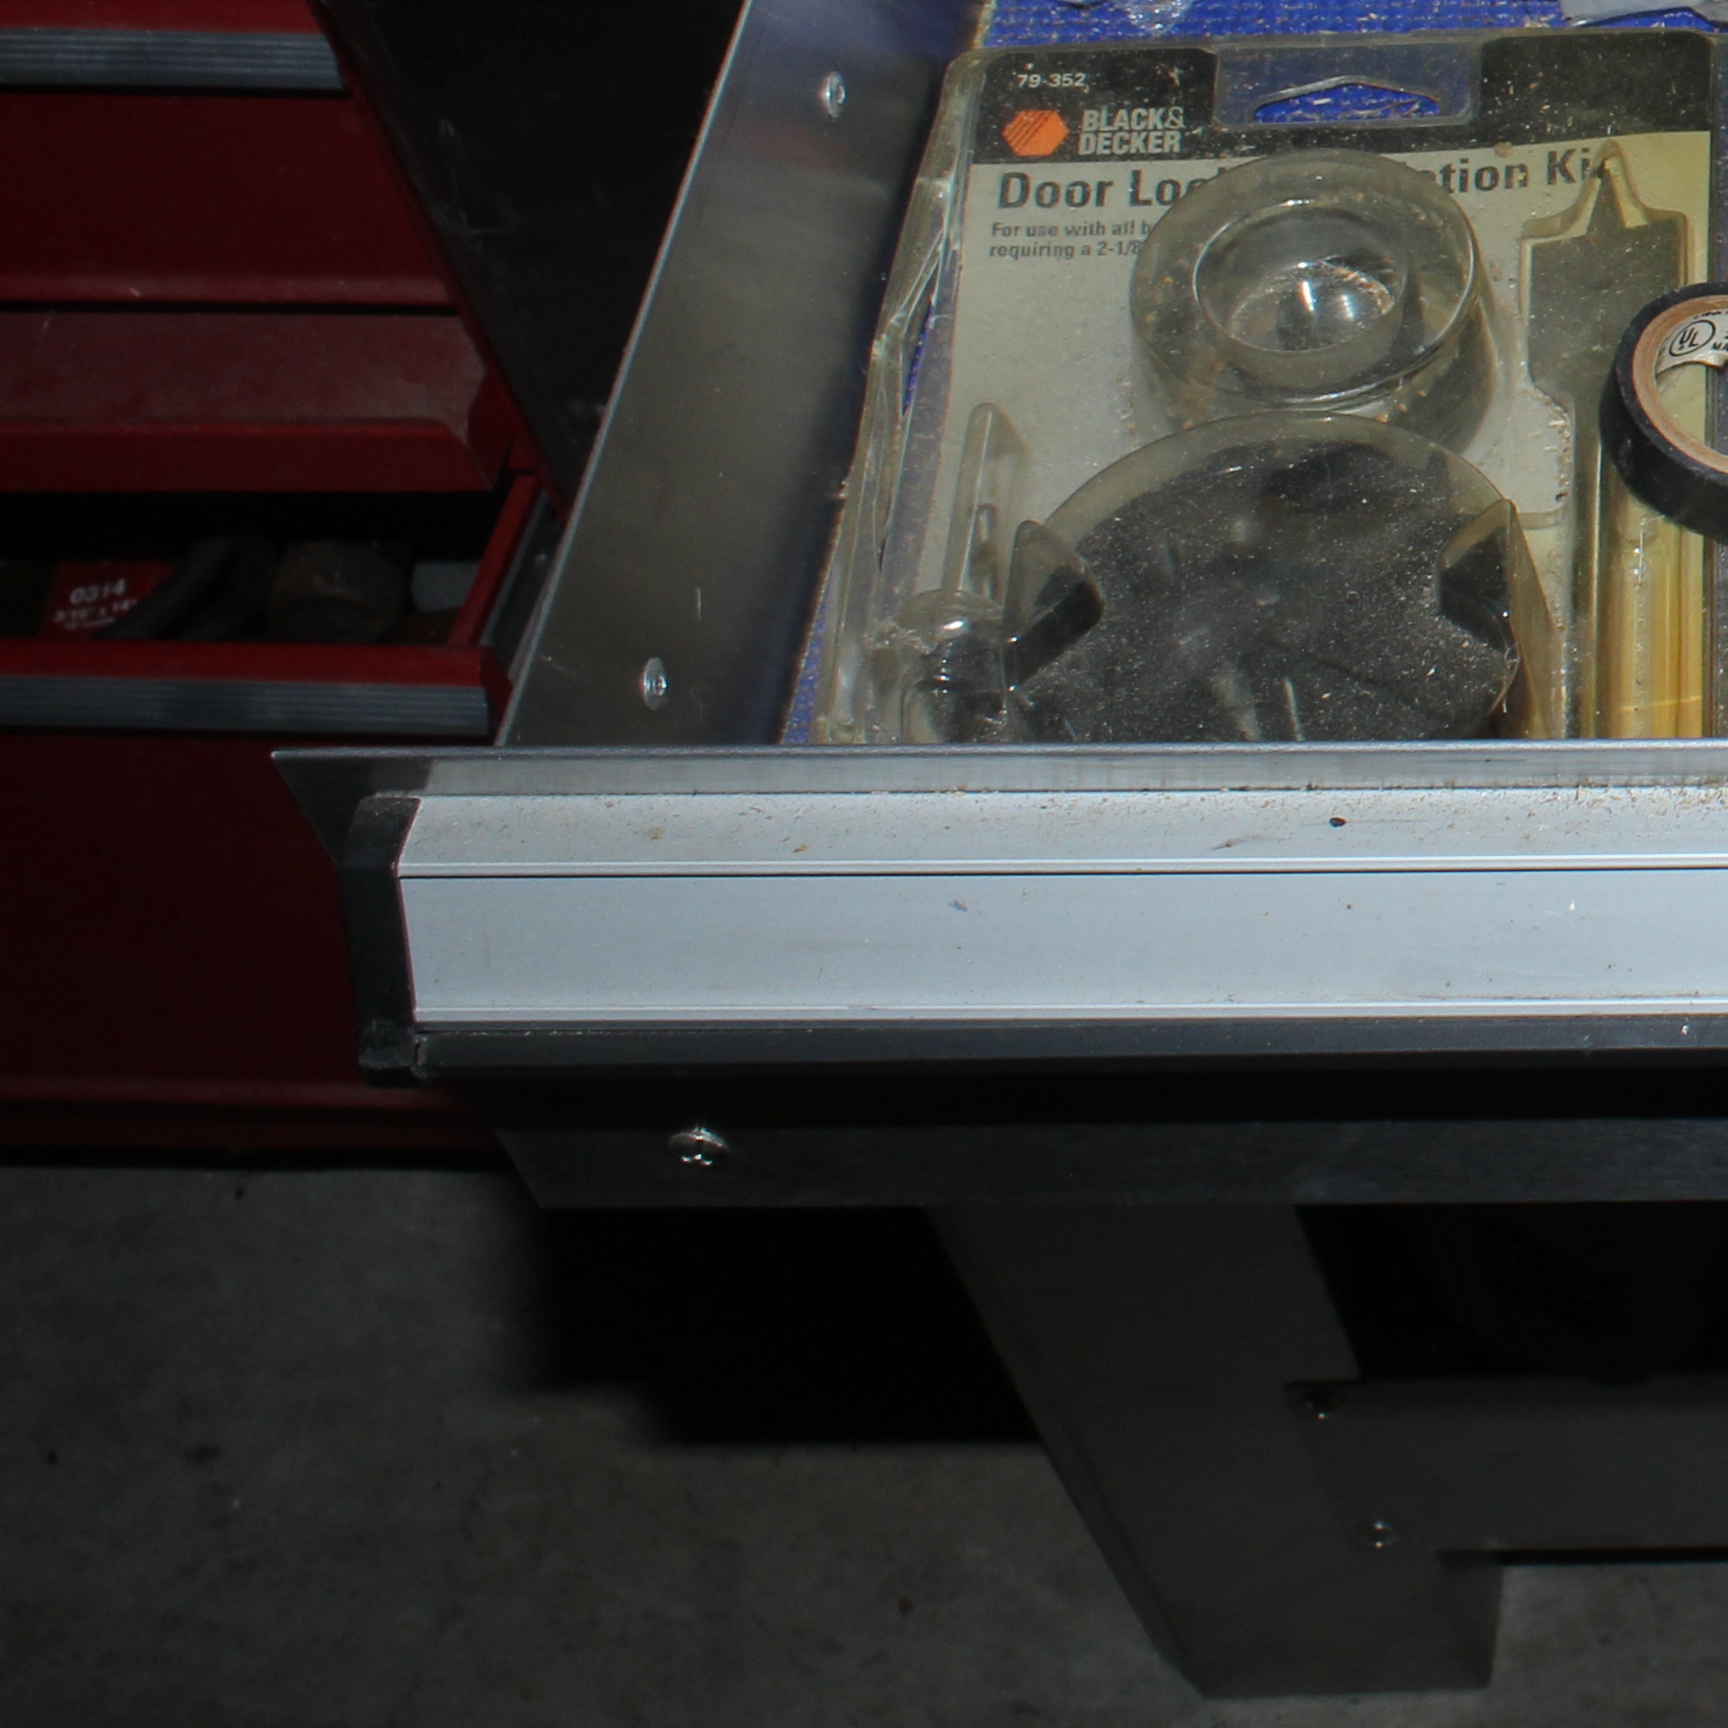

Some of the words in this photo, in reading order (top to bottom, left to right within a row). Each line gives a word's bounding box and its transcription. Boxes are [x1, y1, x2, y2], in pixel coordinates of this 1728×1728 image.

[1017, 72, 1088, 89] 79-352
[1078, 130, 1182, 156] DECKER
[998, 170, 1115, 209] Door
[991, 222, 1020, 238] For
[1025, 223, 1058, 237] use
[1064, 221, 1105, 236] with
[1111, 221, 1135, 236] all
[990, 242, 1075, 260] requiring
[1080, 244, 1092, 256] a
[1678, 326, 1700, 348] UL
